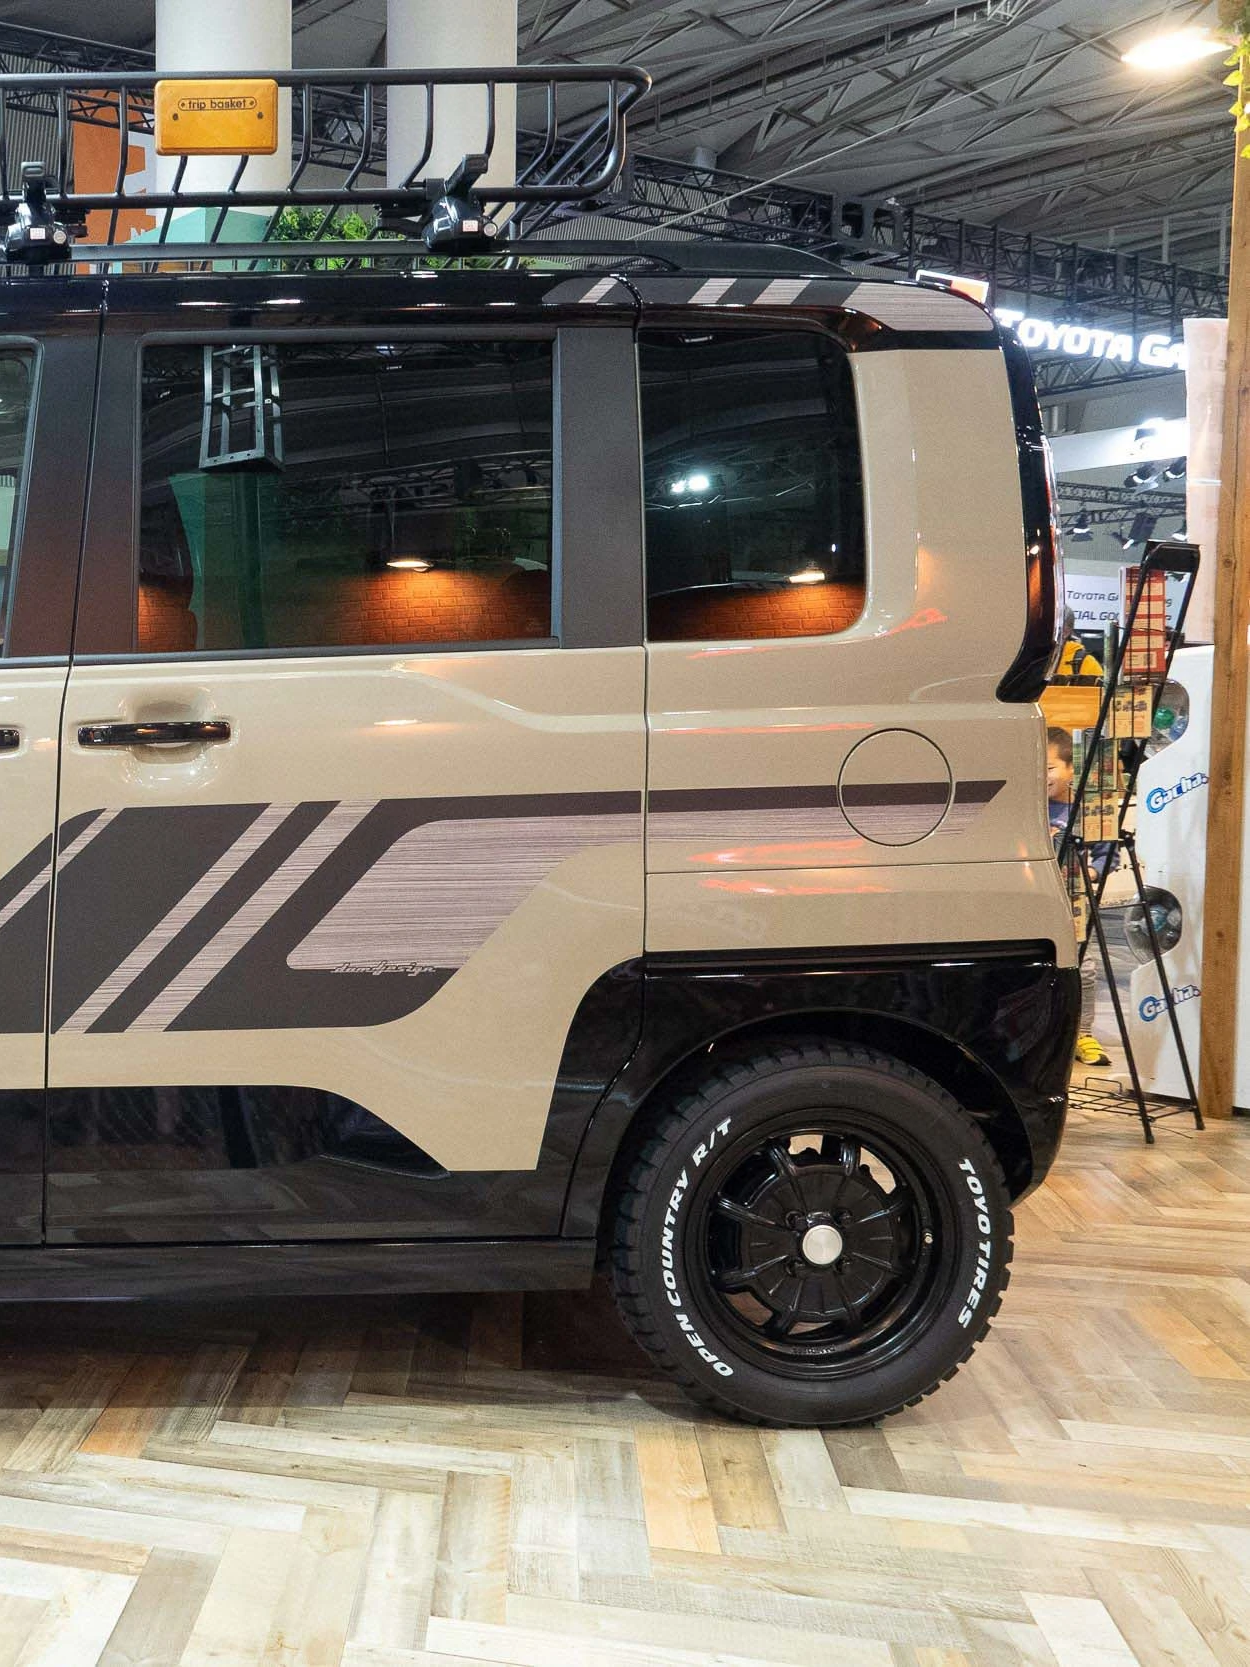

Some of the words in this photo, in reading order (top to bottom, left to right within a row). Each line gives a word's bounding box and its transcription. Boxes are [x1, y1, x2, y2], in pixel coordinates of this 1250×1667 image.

[188, 99, 207, 111] trip
[210, 98, 248, 110] basket
[993, 307, 1134, 363] TOYOTA
[1066, 590, 1106, 601] TOYOTA
[692, 1116, 732, 1167] R/T
[958, 1158, 991, 1235] TOYO
[661, 1168, 689, 1308] COUNTRY
[957, 1240, 991, 1329] TIRES
[675, 1312, 735, 1377] OPEN
